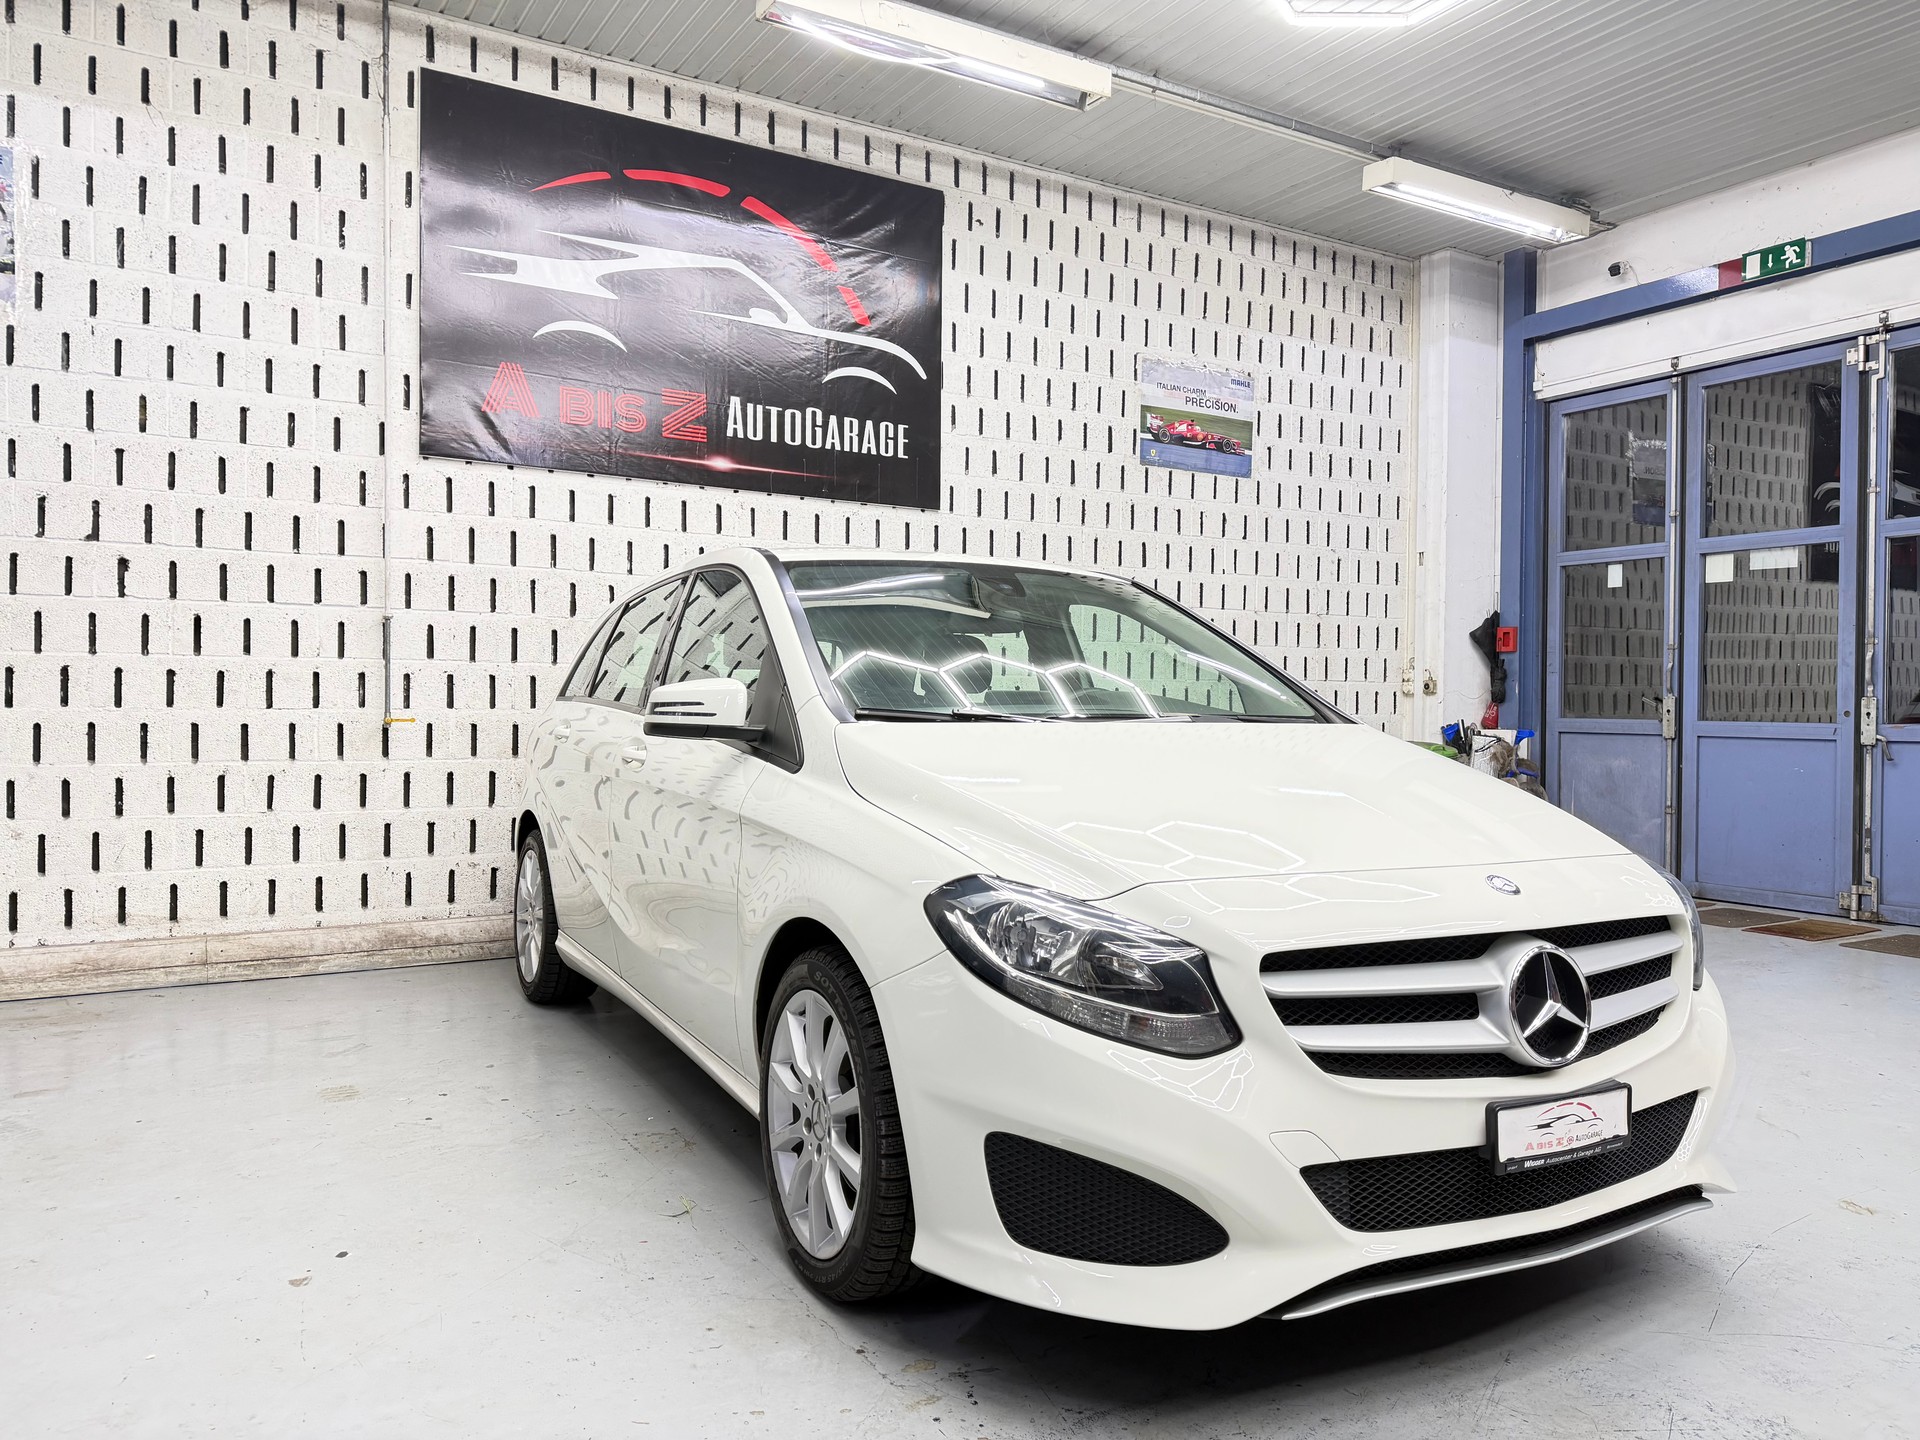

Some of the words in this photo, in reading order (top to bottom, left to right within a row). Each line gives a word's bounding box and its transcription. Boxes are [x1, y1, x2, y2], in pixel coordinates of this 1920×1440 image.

[1156, 382, 1182, 392] ITALIAN
[1182, 386, 1207, 397] CHARM
[1230, 378, 1251, 389] MAHLE
[482, 361, 538, 418] A
[559, 385, 647, 433] BIS
[661, 388, 708, 443] Z
[1185, 397, 1239, 414] PRECISION.
